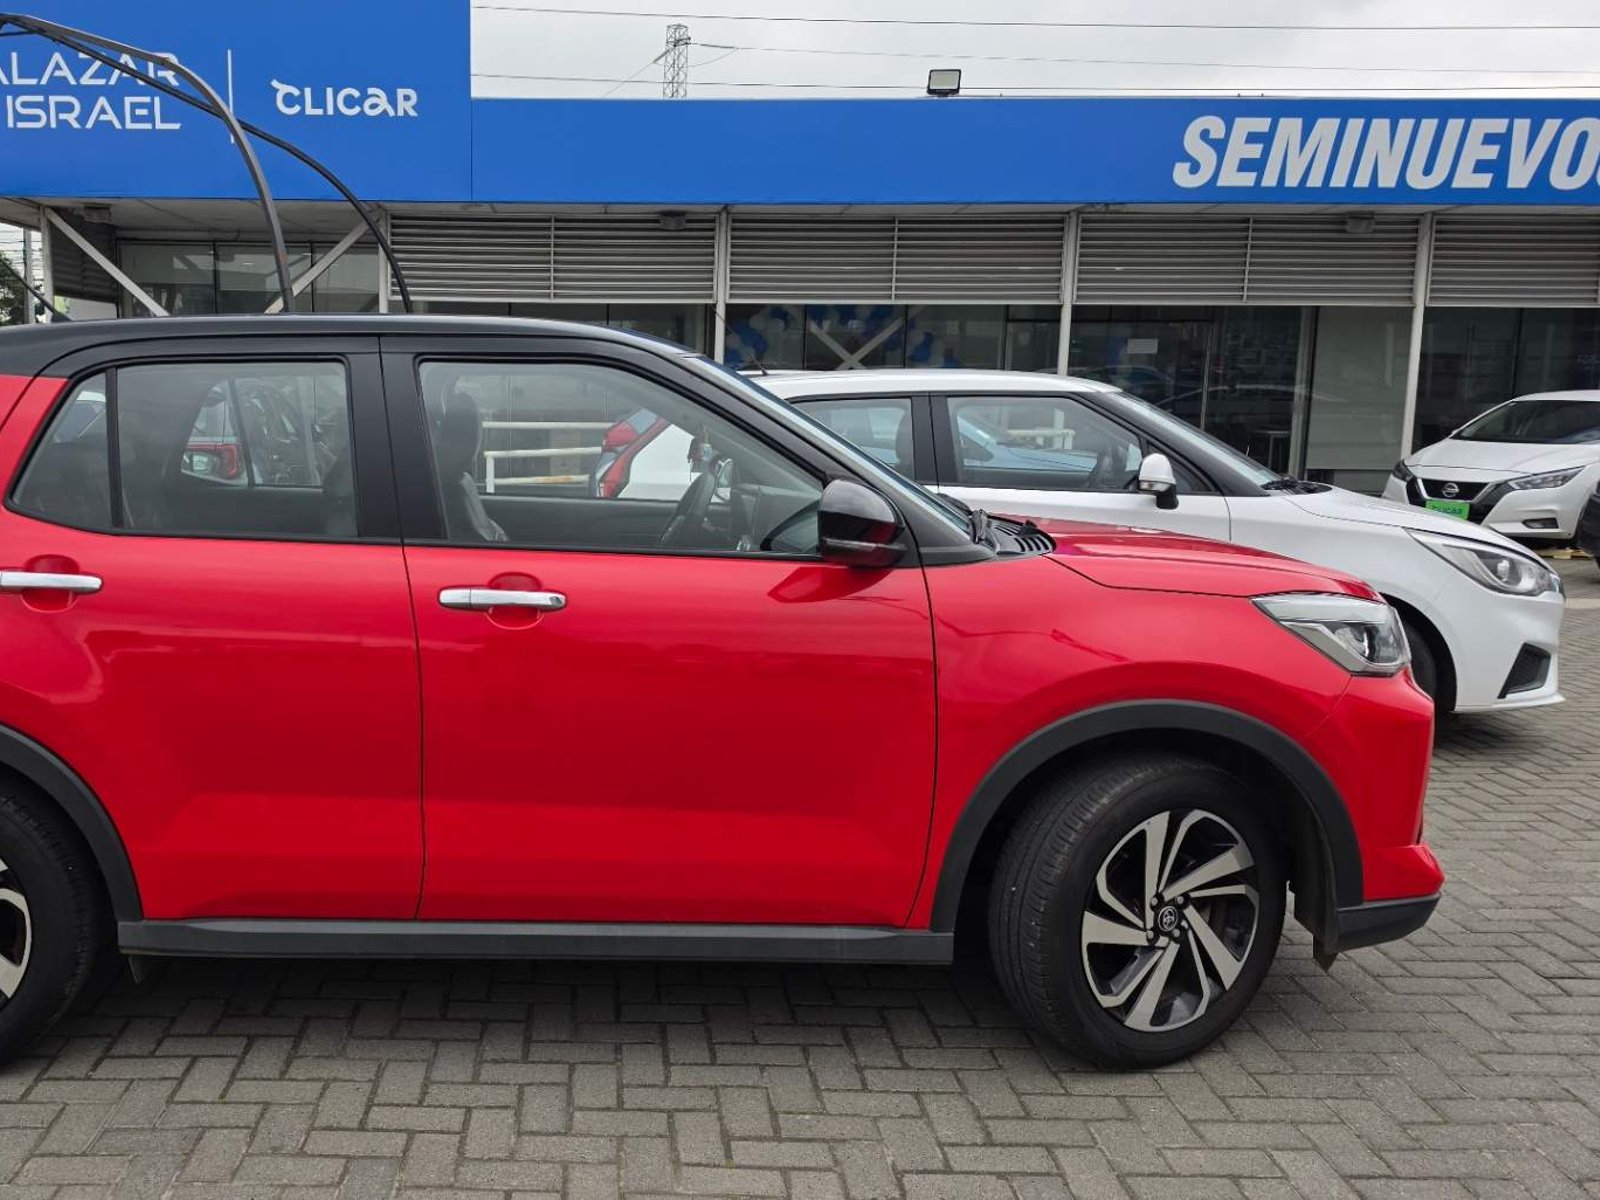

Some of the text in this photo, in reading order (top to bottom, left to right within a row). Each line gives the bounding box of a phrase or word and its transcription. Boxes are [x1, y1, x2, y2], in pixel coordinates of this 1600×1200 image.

[0, 51, 181, 86] LAZAR
[6, 95, 181, 129] ISRAEL
[1172, 115, 1600, 190] SEMINUEVO
